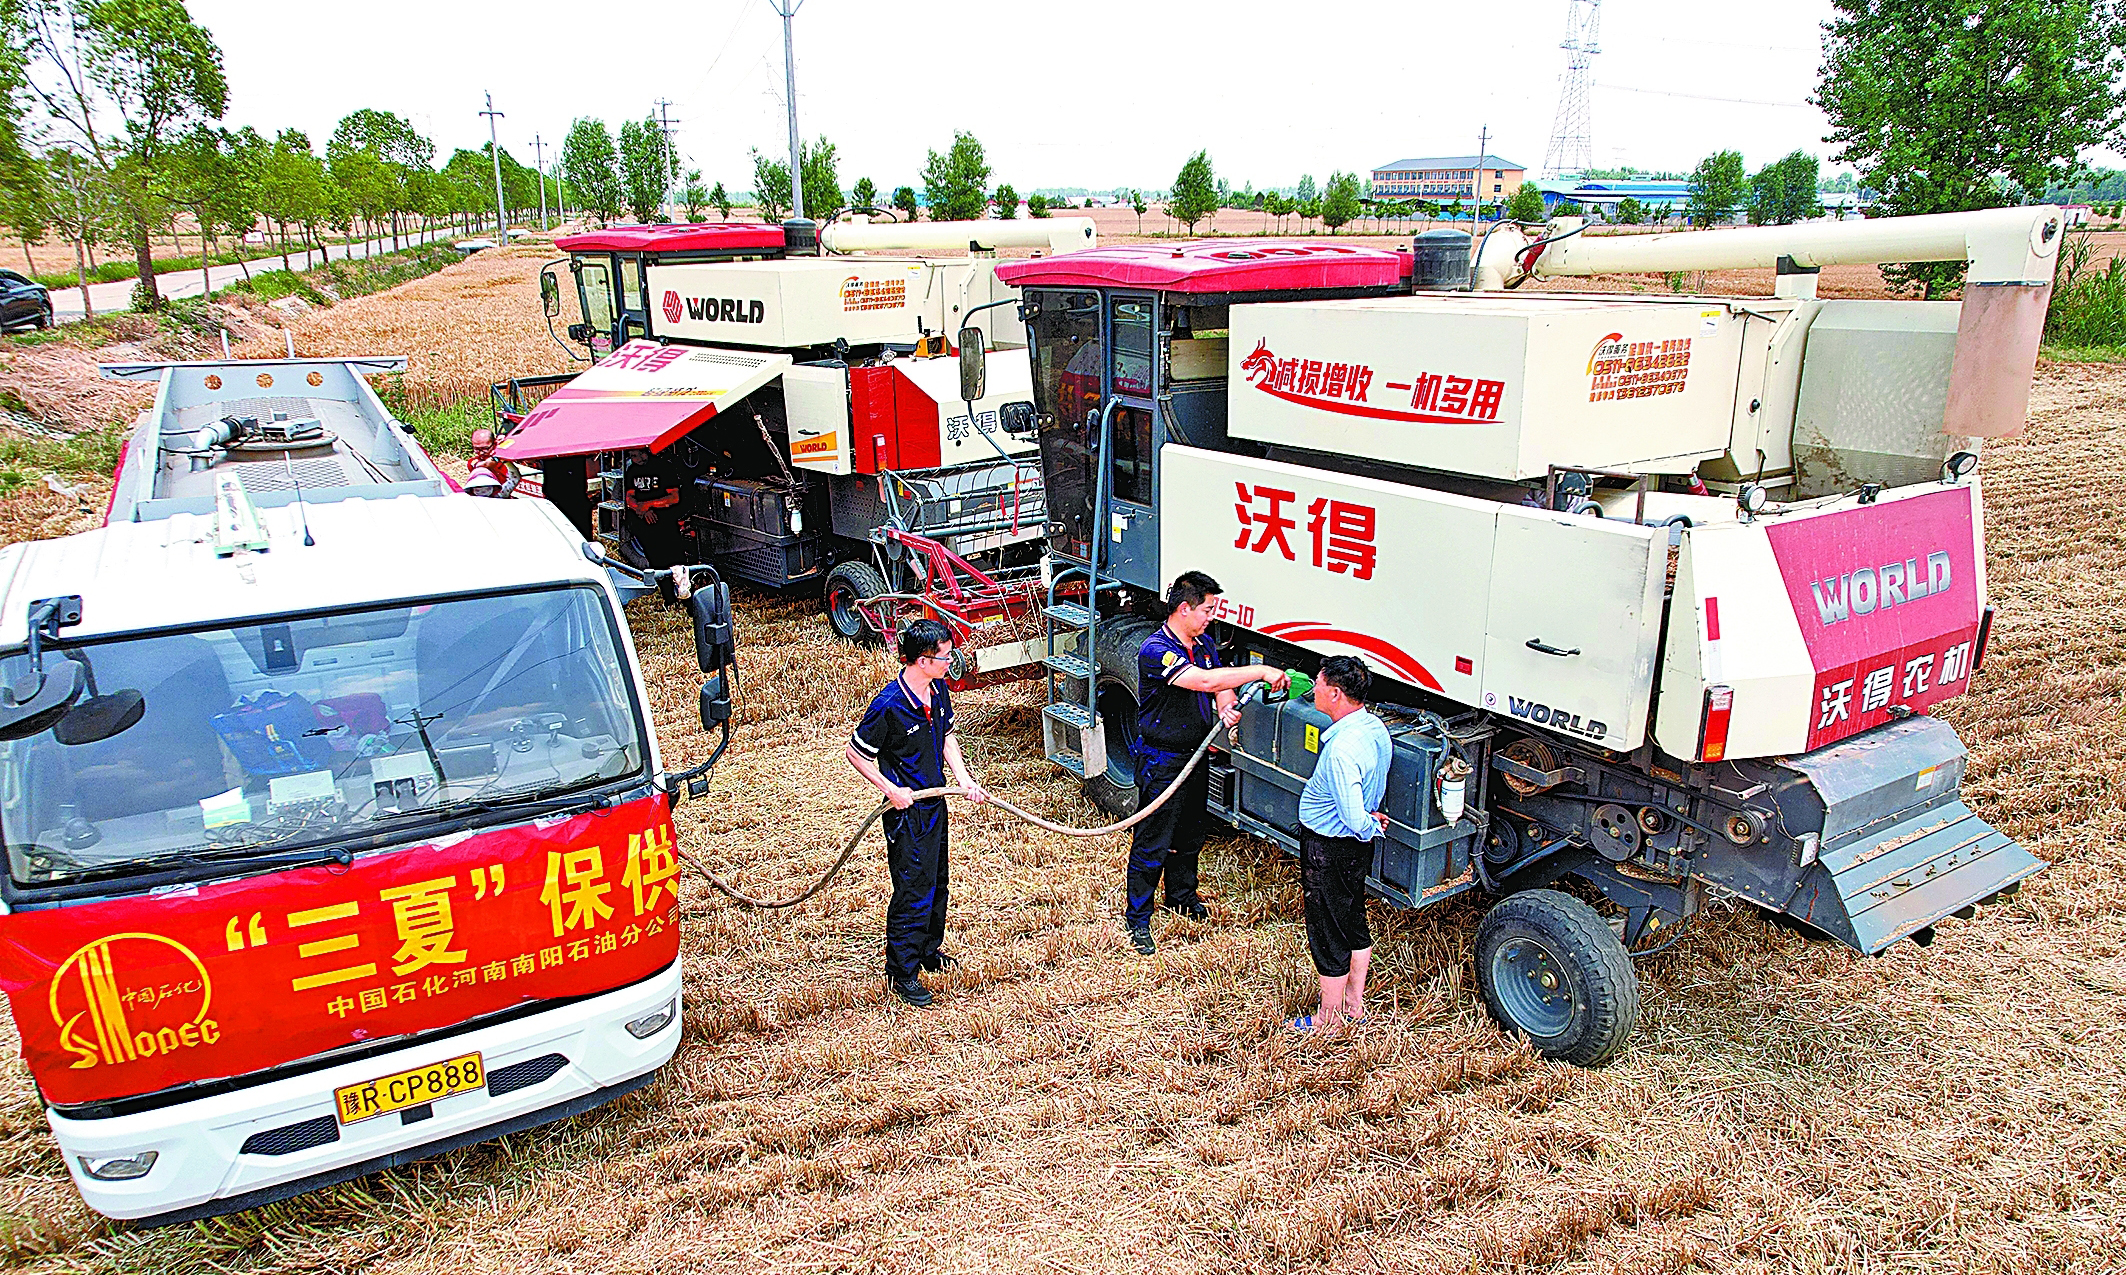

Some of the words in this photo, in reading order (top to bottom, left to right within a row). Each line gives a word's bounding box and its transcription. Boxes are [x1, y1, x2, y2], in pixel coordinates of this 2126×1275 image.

[685, 297, 765, 324] WORLD
[597, 343, 689, 373] 沃得
[1274, 357, 1374, 402] 减损增收
[1386, 371, 1505, 420] 一机多用
[800, 442, 827, 453] WORLD
[947, 410, 997, 440] 沃得
[1234, 481, 1377, 580] 沃得
[1810, 550, 1952, 626] WORLD
[1817, 641, 1971, 731] 沃得农机
[1508, 695, 1608, 741] WORLD
[540, 824, 681, 938] 保供
[327, 904, 679, 1020] 中国石化河南南阳石油分公司
